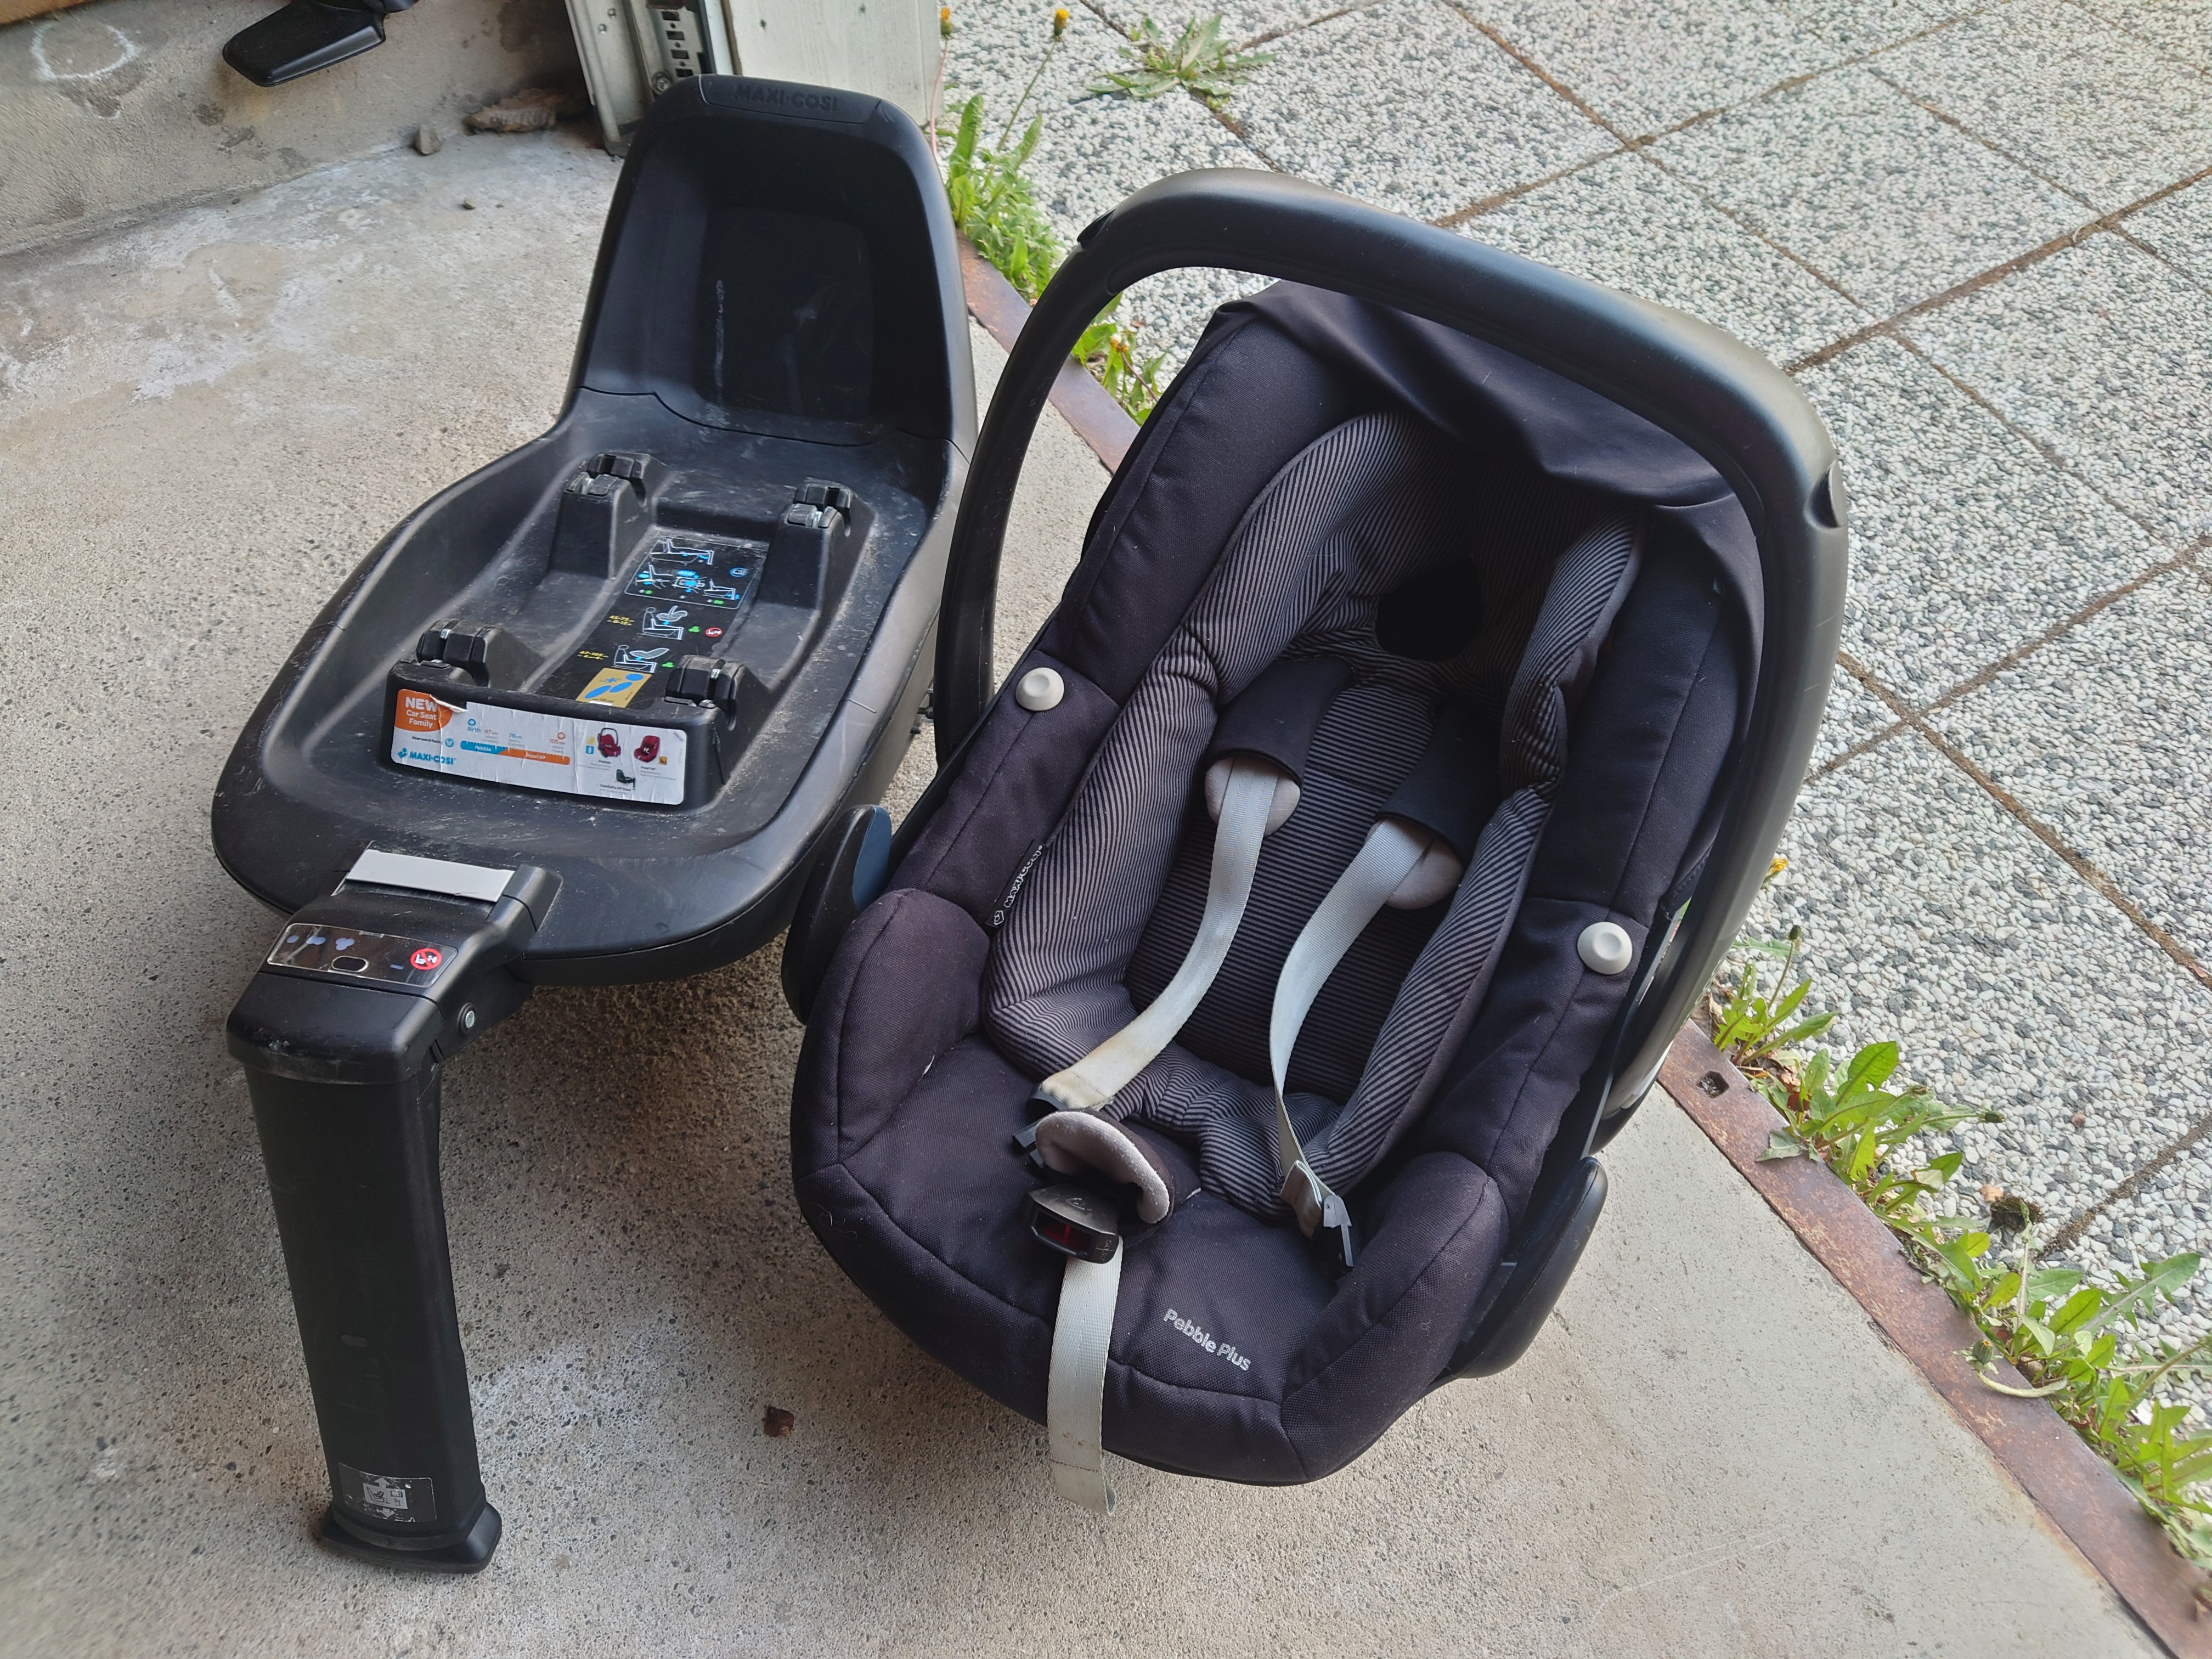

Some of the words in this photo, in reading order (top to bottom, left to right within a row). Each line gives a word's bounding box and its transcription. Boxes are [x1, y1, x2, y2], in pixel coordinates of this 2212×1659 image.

[405, 696, 438, 712] NEW
[406, 709, 418, 718] Car
[420, 712, 437, 720] Seat
[409, 718, 433, 729] Family
[1163, 1308, 1217, 1353] Pebble
[1216, 1343, 1252, 1371] Plus
